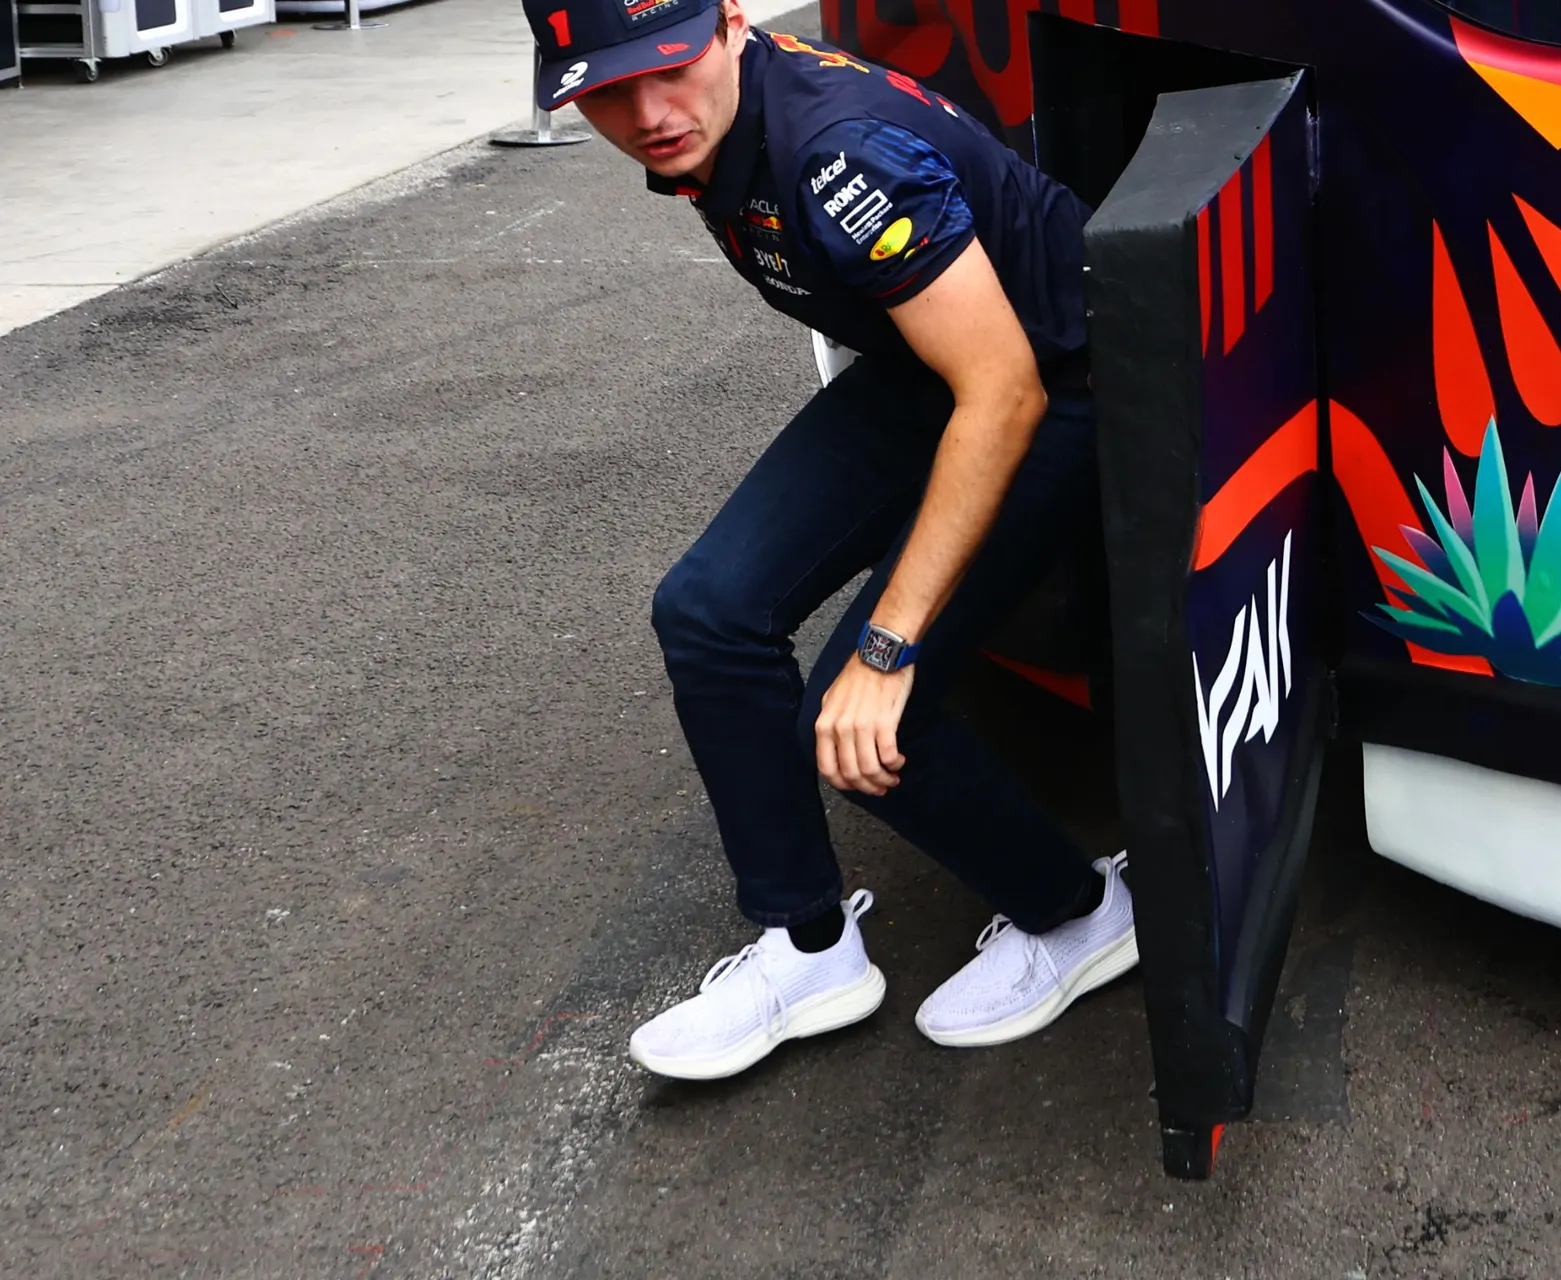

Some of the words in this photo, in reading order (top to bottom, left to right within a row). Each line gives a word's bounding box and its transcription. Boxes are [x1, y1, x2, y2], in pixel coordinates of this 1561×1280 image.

[547, 9, 572, 48] 1
[810, 151, 847, 195] telcel
[823, 173, 868, 218] ROKT
